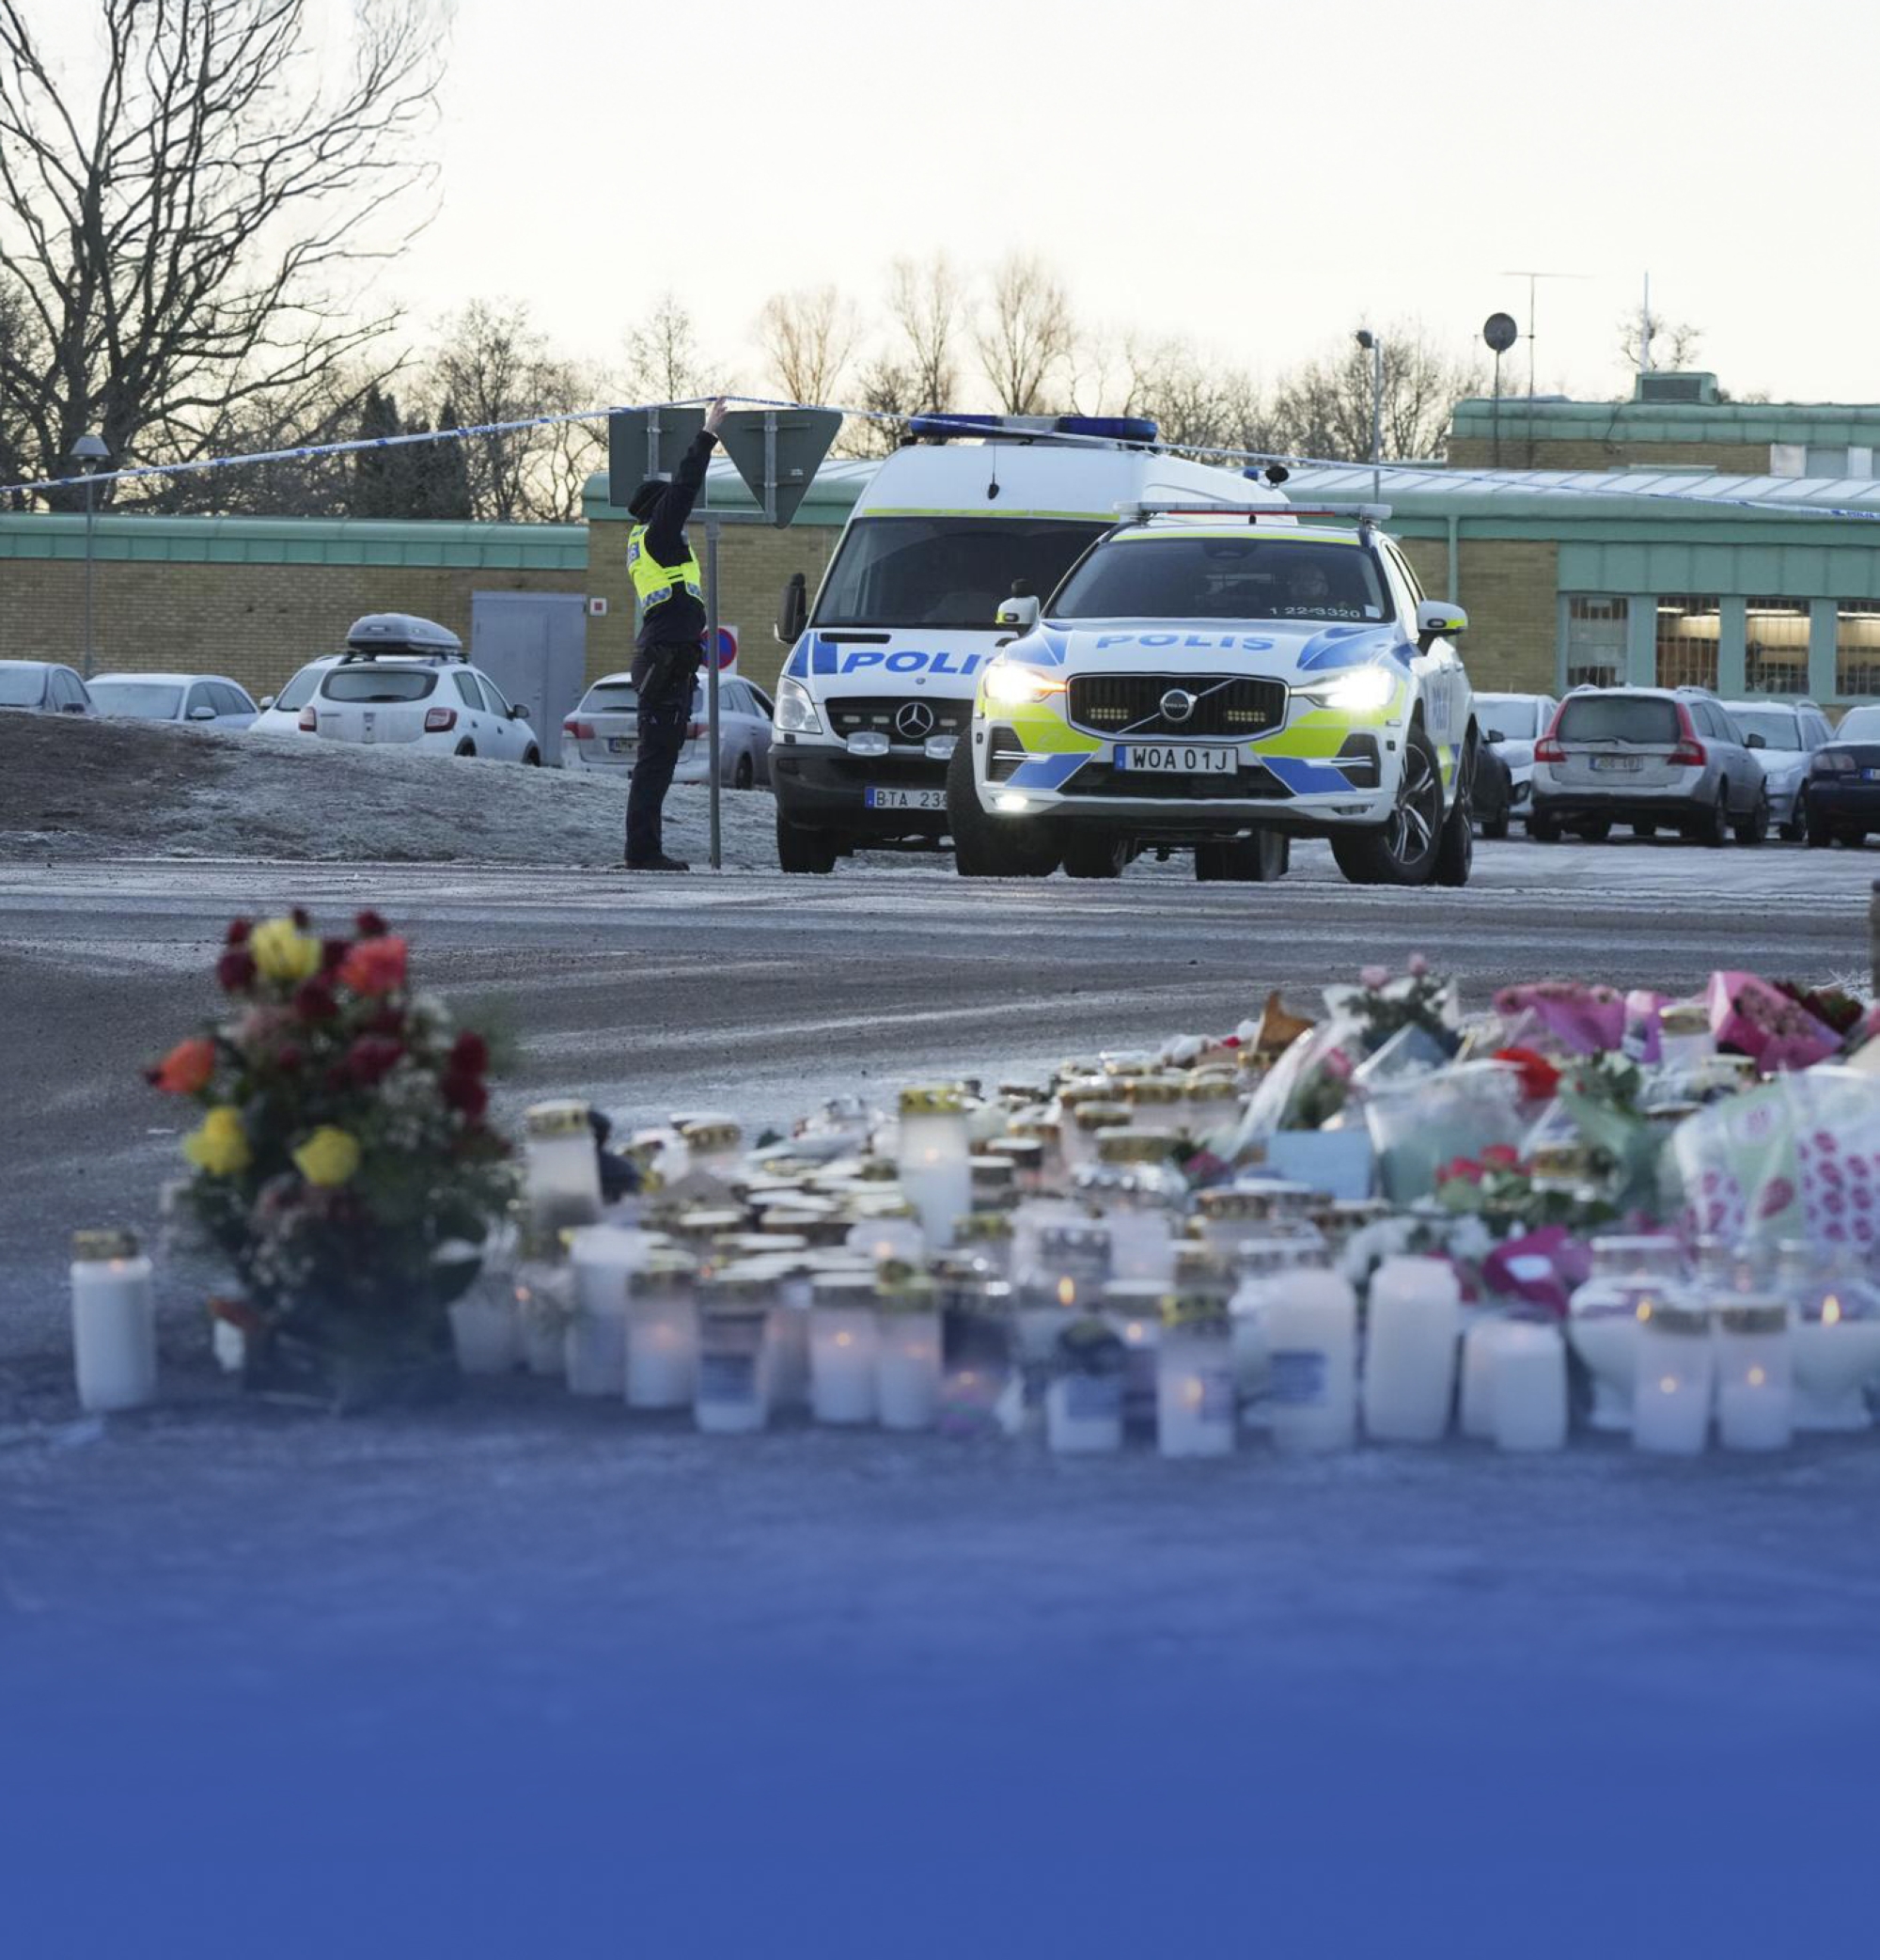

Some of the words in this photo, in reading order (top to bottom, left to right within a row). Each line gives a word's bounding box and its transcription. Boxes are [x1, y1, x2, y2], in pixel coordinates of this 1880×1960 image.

[1096, 634, 1276, 651] POLIS
[840, 651, 993, 675] POLI
[1132, 748, 1176, 769] WOA
[1184, 749, 1228, 770] 01J
[876, 791, 908, 807] BTA
